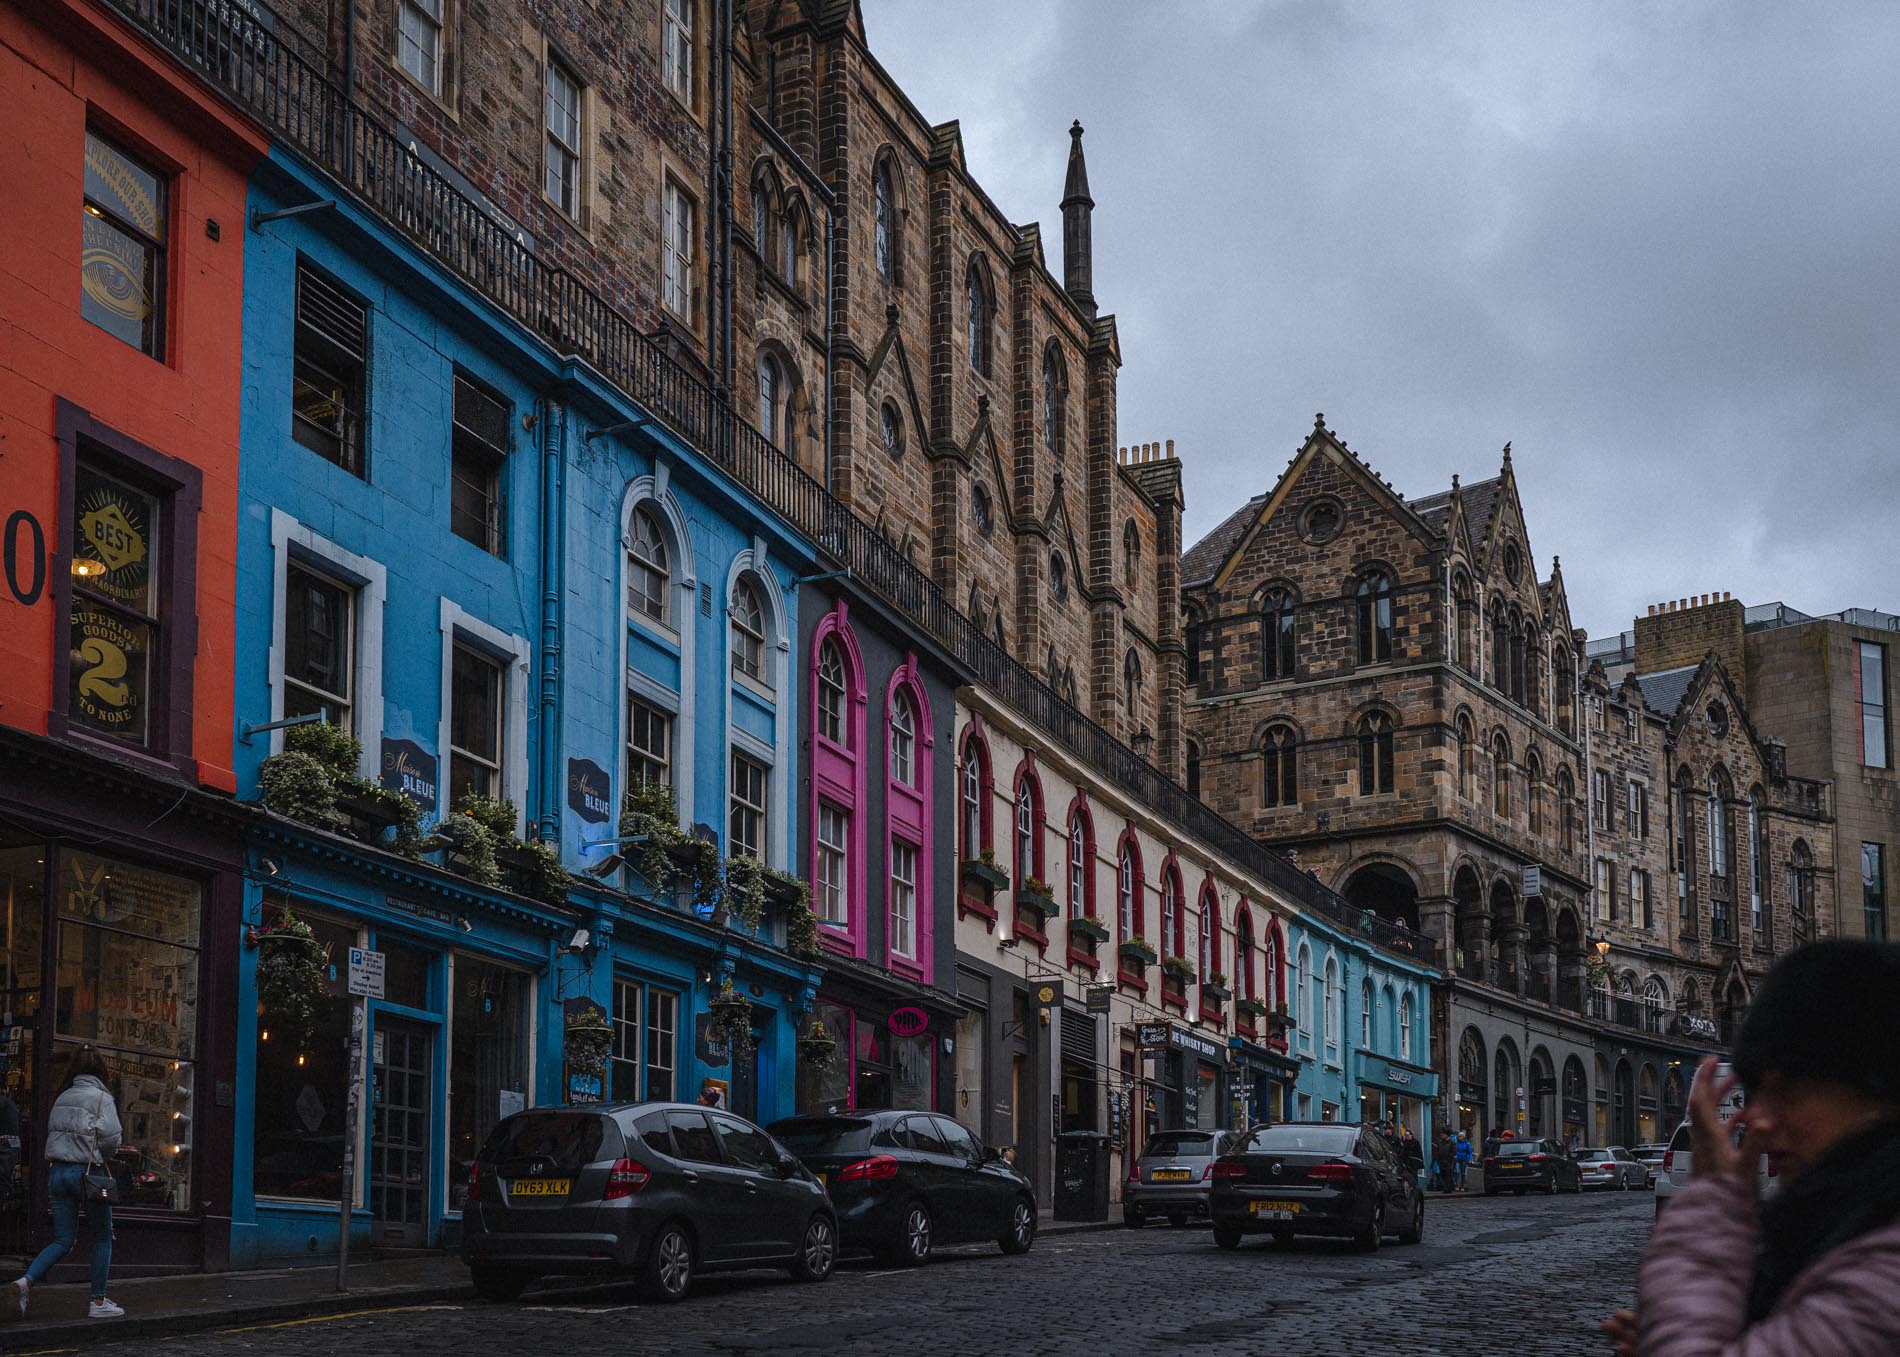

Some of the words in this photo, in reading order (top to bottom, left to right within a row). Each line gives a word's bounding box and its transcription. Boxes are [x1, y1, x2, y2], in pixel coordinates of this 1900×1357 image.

[85, 140, 120, 180] XPLORE
[119, 176, 137, 201] OUR
[96, 520, 133, 553] BEST
[71, 612, 141, 649] SUPERIOR
[80, 697, 96, 715] TO
[98, 709, 132, 722] NONE
[403, 773, 435, 801] BLEUE
[585, 793, 609, 816] BLEUE
[1171, 1030, 1180, 1044] HE
[1180, 1032, 1201, 1052] WHISKY
[1201, 1041, 1216, 1057] SHOP
[546, 1182, 567, 1193] XLK
